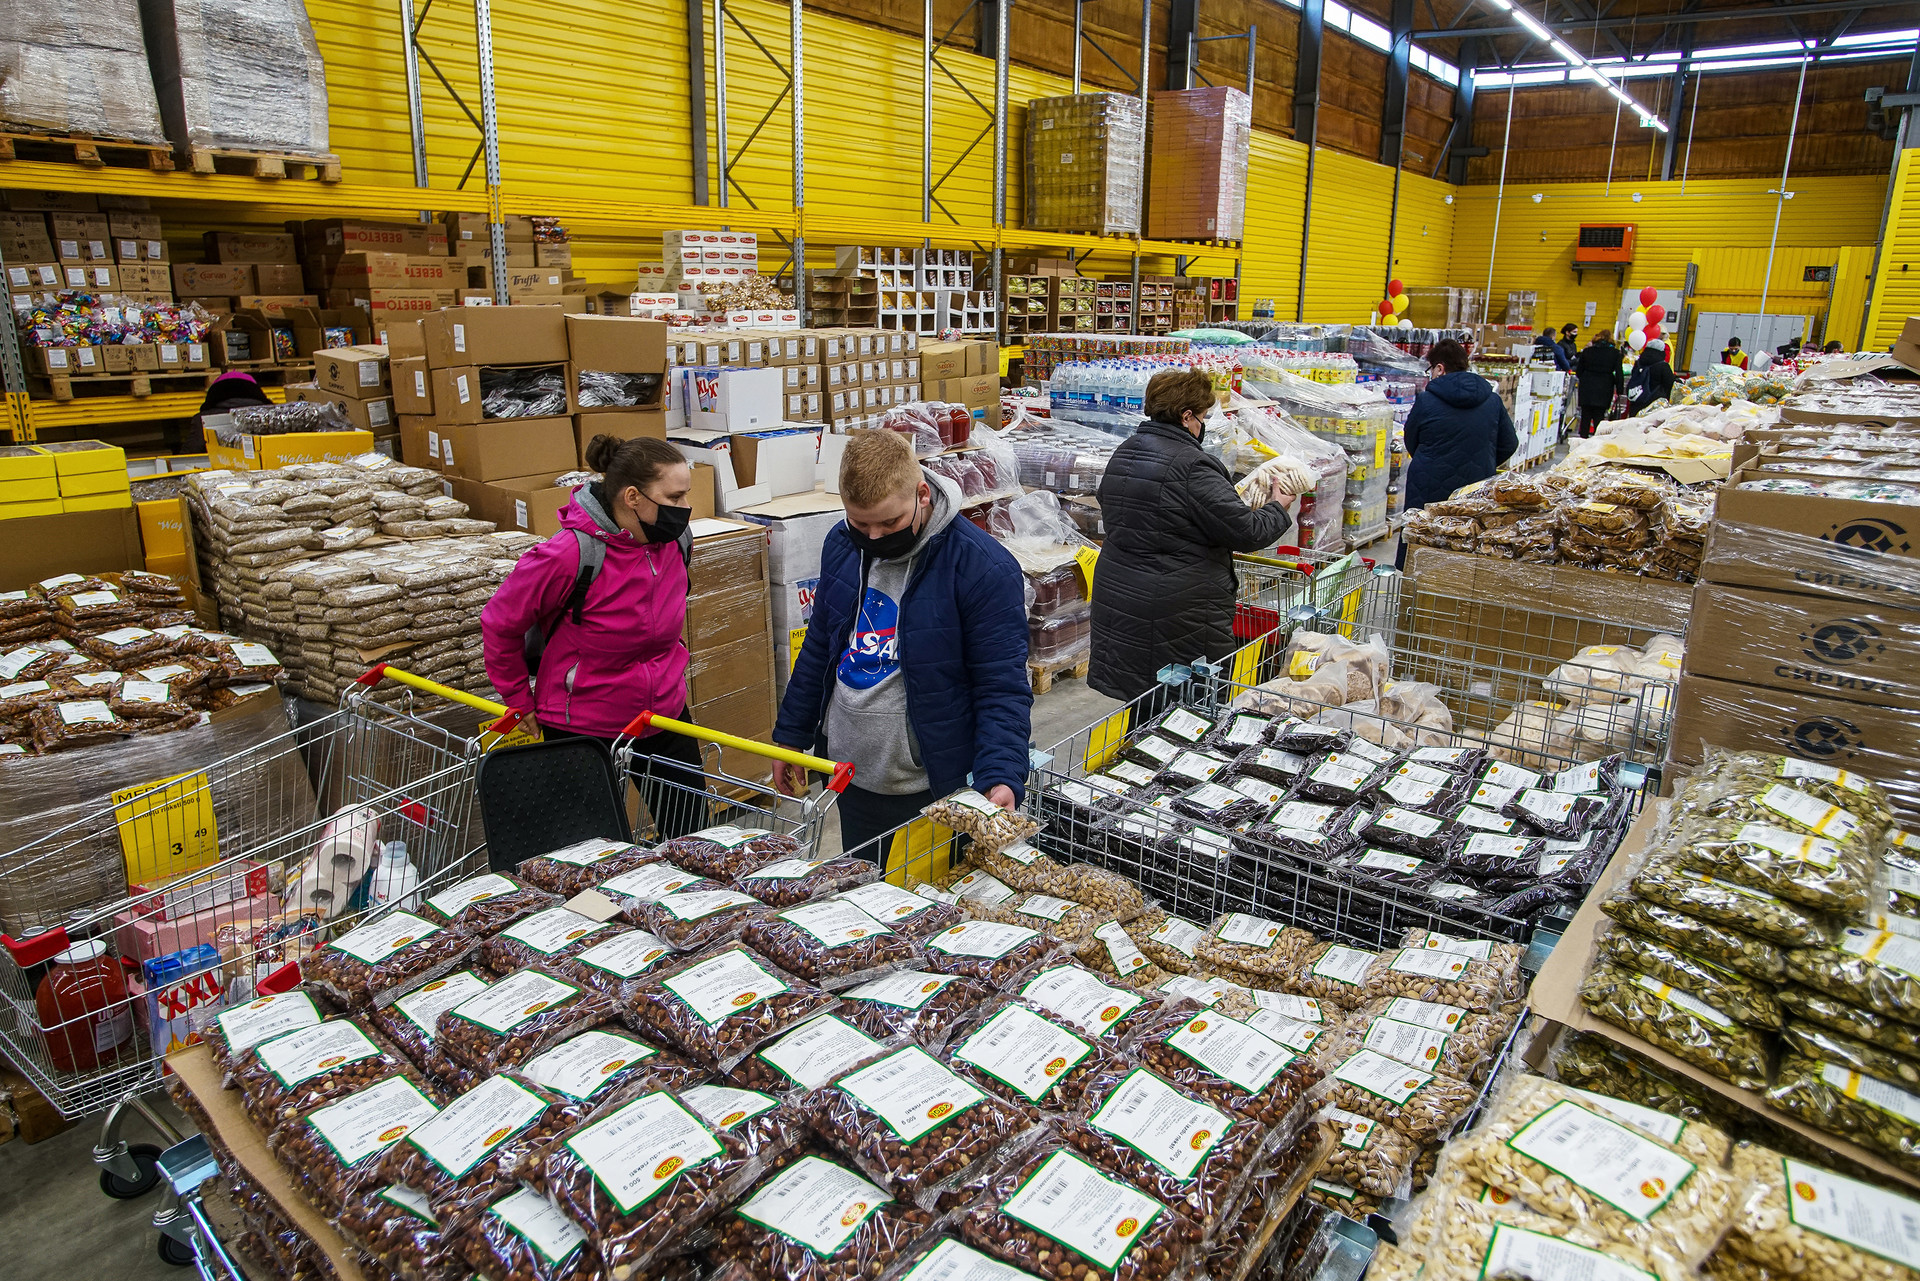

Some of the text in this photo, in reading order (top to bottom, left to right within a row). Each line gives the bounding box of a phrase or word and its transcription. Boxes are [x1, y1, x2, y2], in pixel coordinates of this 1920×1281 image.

[358, 231, 402, 243] BEBETO
[387, 300, 432, 311] BEBETO
[792, 630, 807, 639] ME
[194, 828, 207, 839] 49
[172, 843, 183, 857] 3
[158, 970, 225, 1022] XXL
